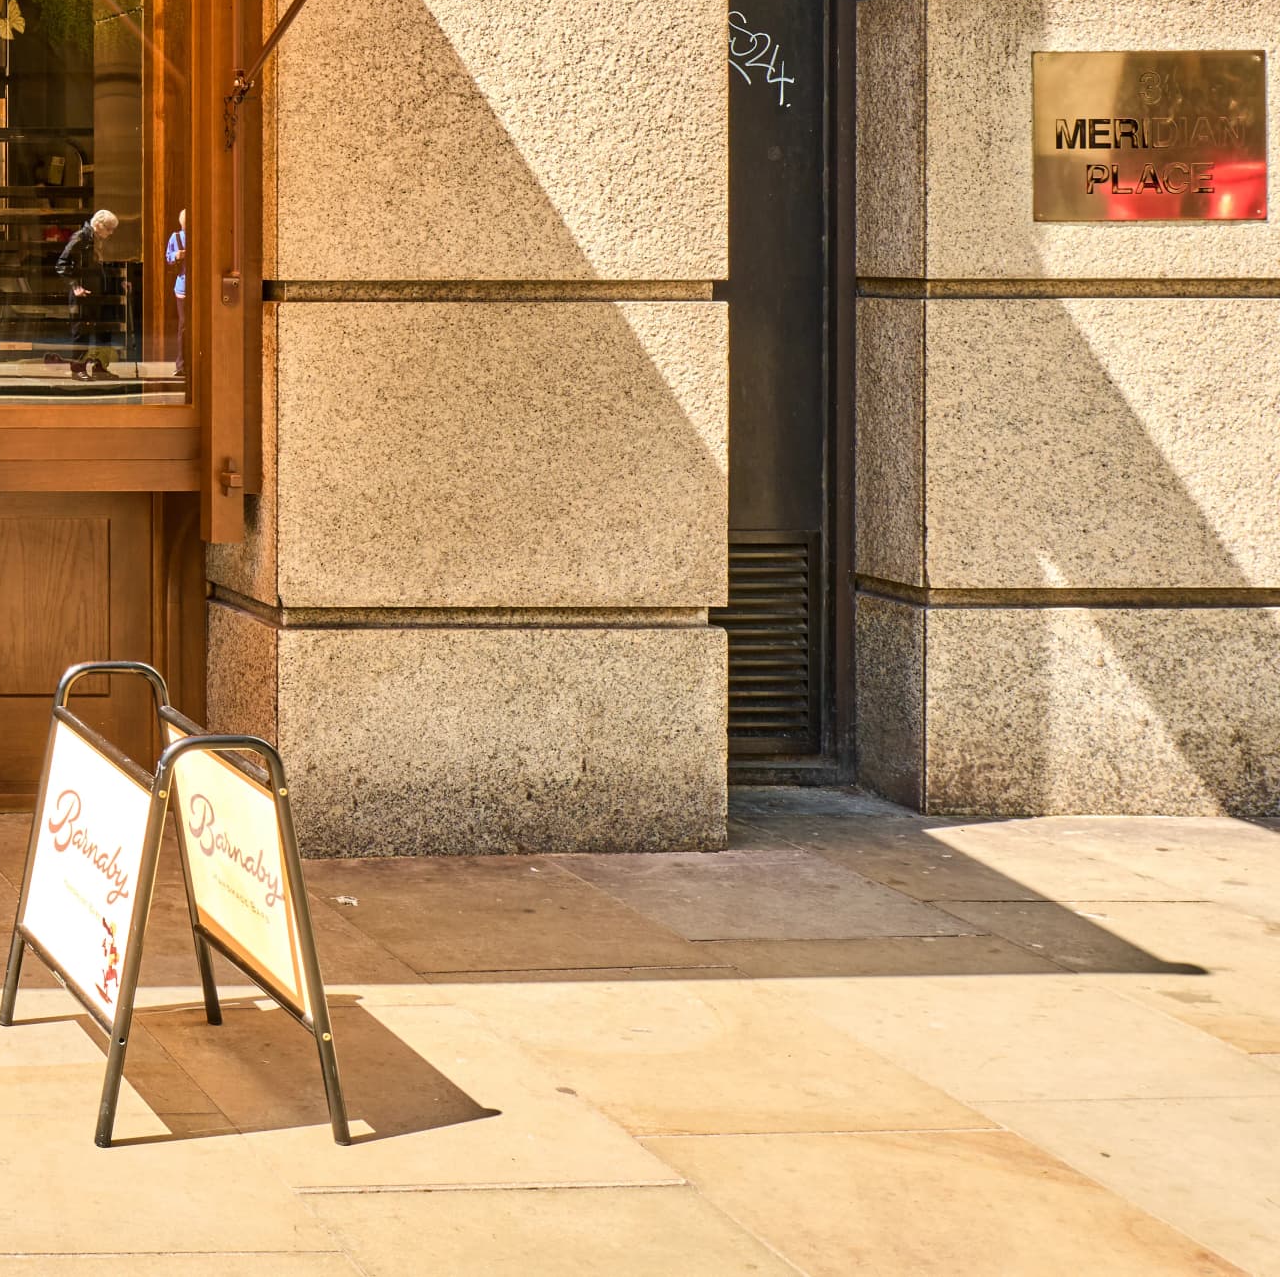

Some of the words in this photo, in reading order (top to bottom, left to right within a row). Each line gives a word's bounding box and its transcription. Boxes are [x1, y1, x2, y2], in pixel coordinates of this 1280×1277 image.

[1055, 116, 1247, 150] MERIDIAN
[1085, 161, 1216, 195] PLACE
[49, 789, 129, 906] Barnaby
[189, 793, 286, 908] Barnaby
